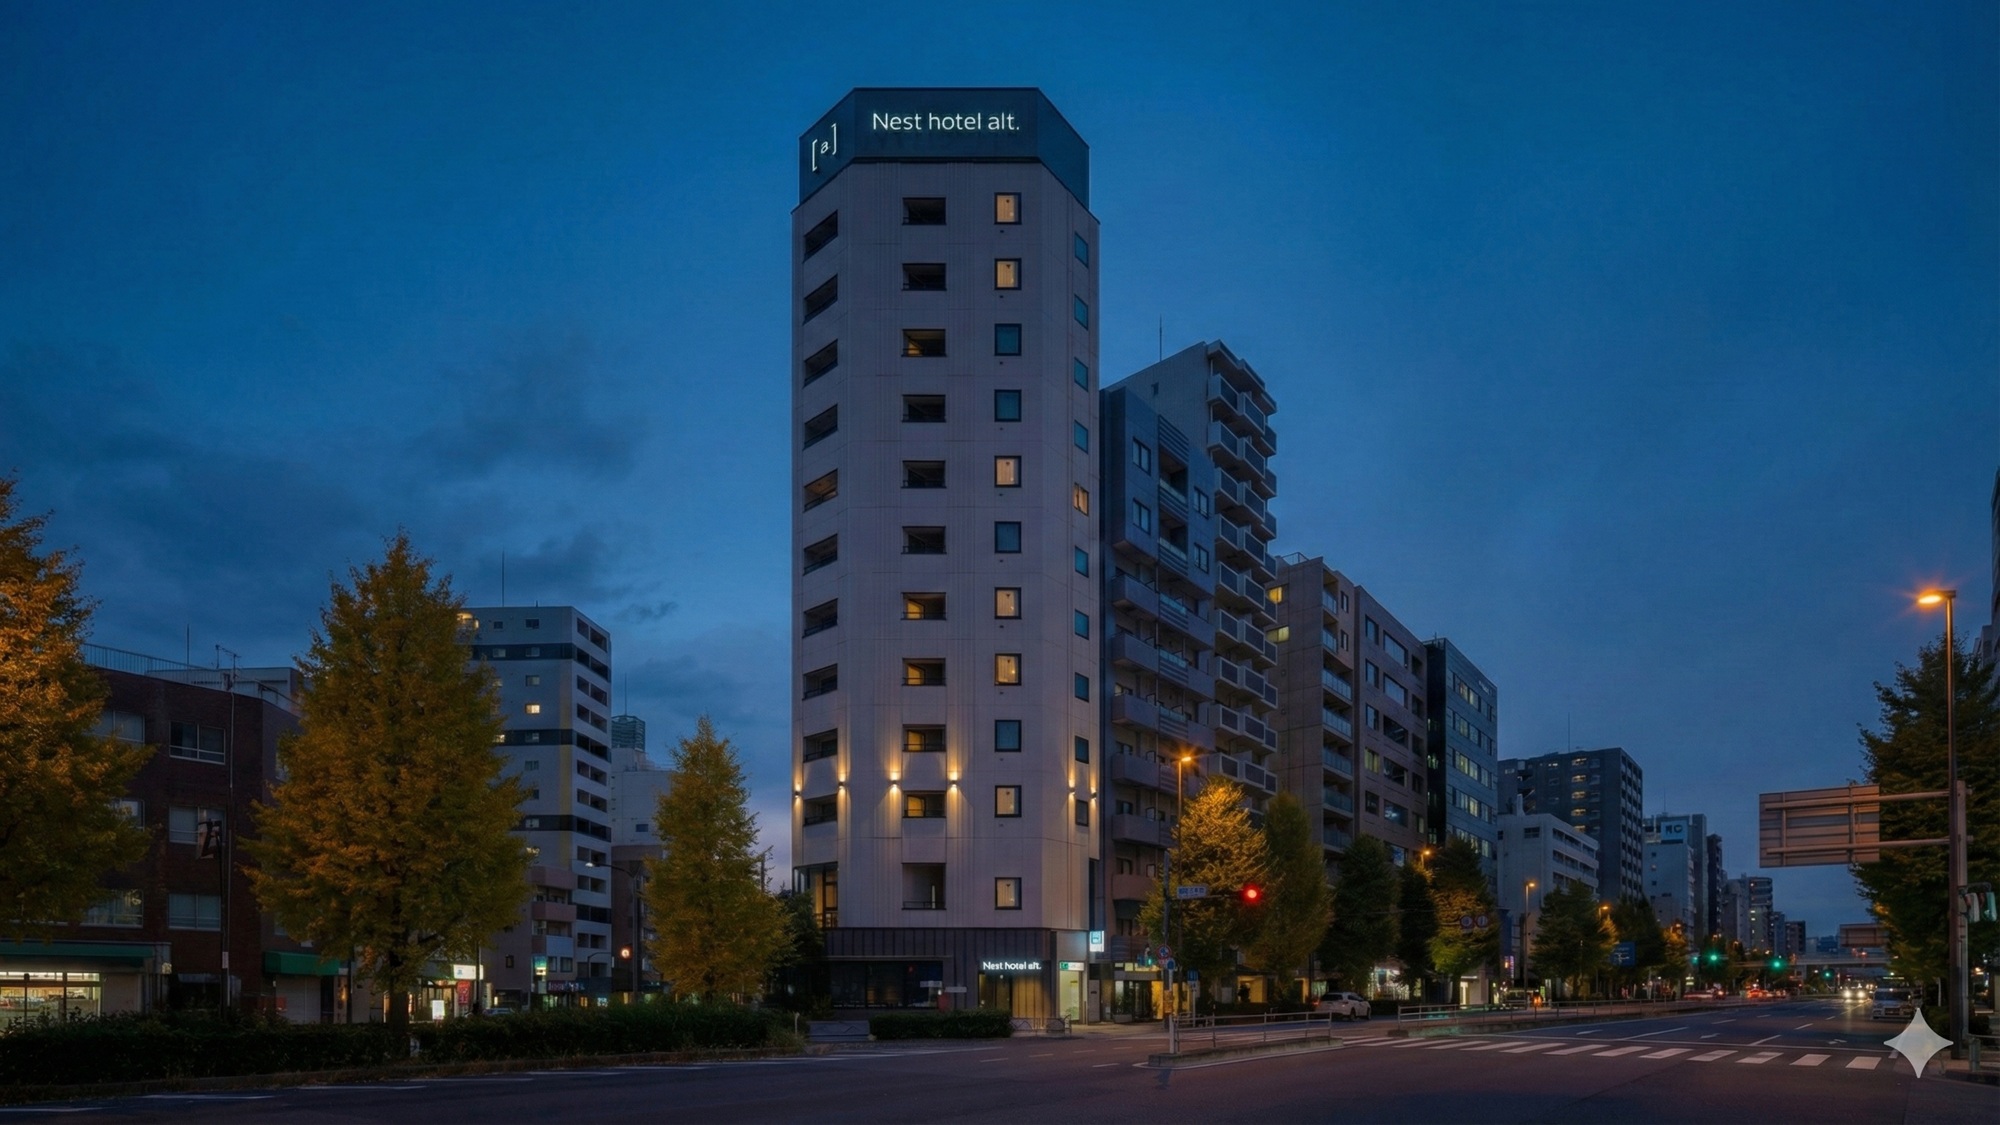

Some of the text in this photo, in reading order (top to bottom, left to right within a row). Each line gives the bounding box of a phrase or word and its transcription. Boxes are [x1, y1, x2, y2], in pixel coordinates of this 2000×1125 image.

[872, 112, 1020, 131] Nest hotel alt.
[982, 961, 1004, 970] Nest
